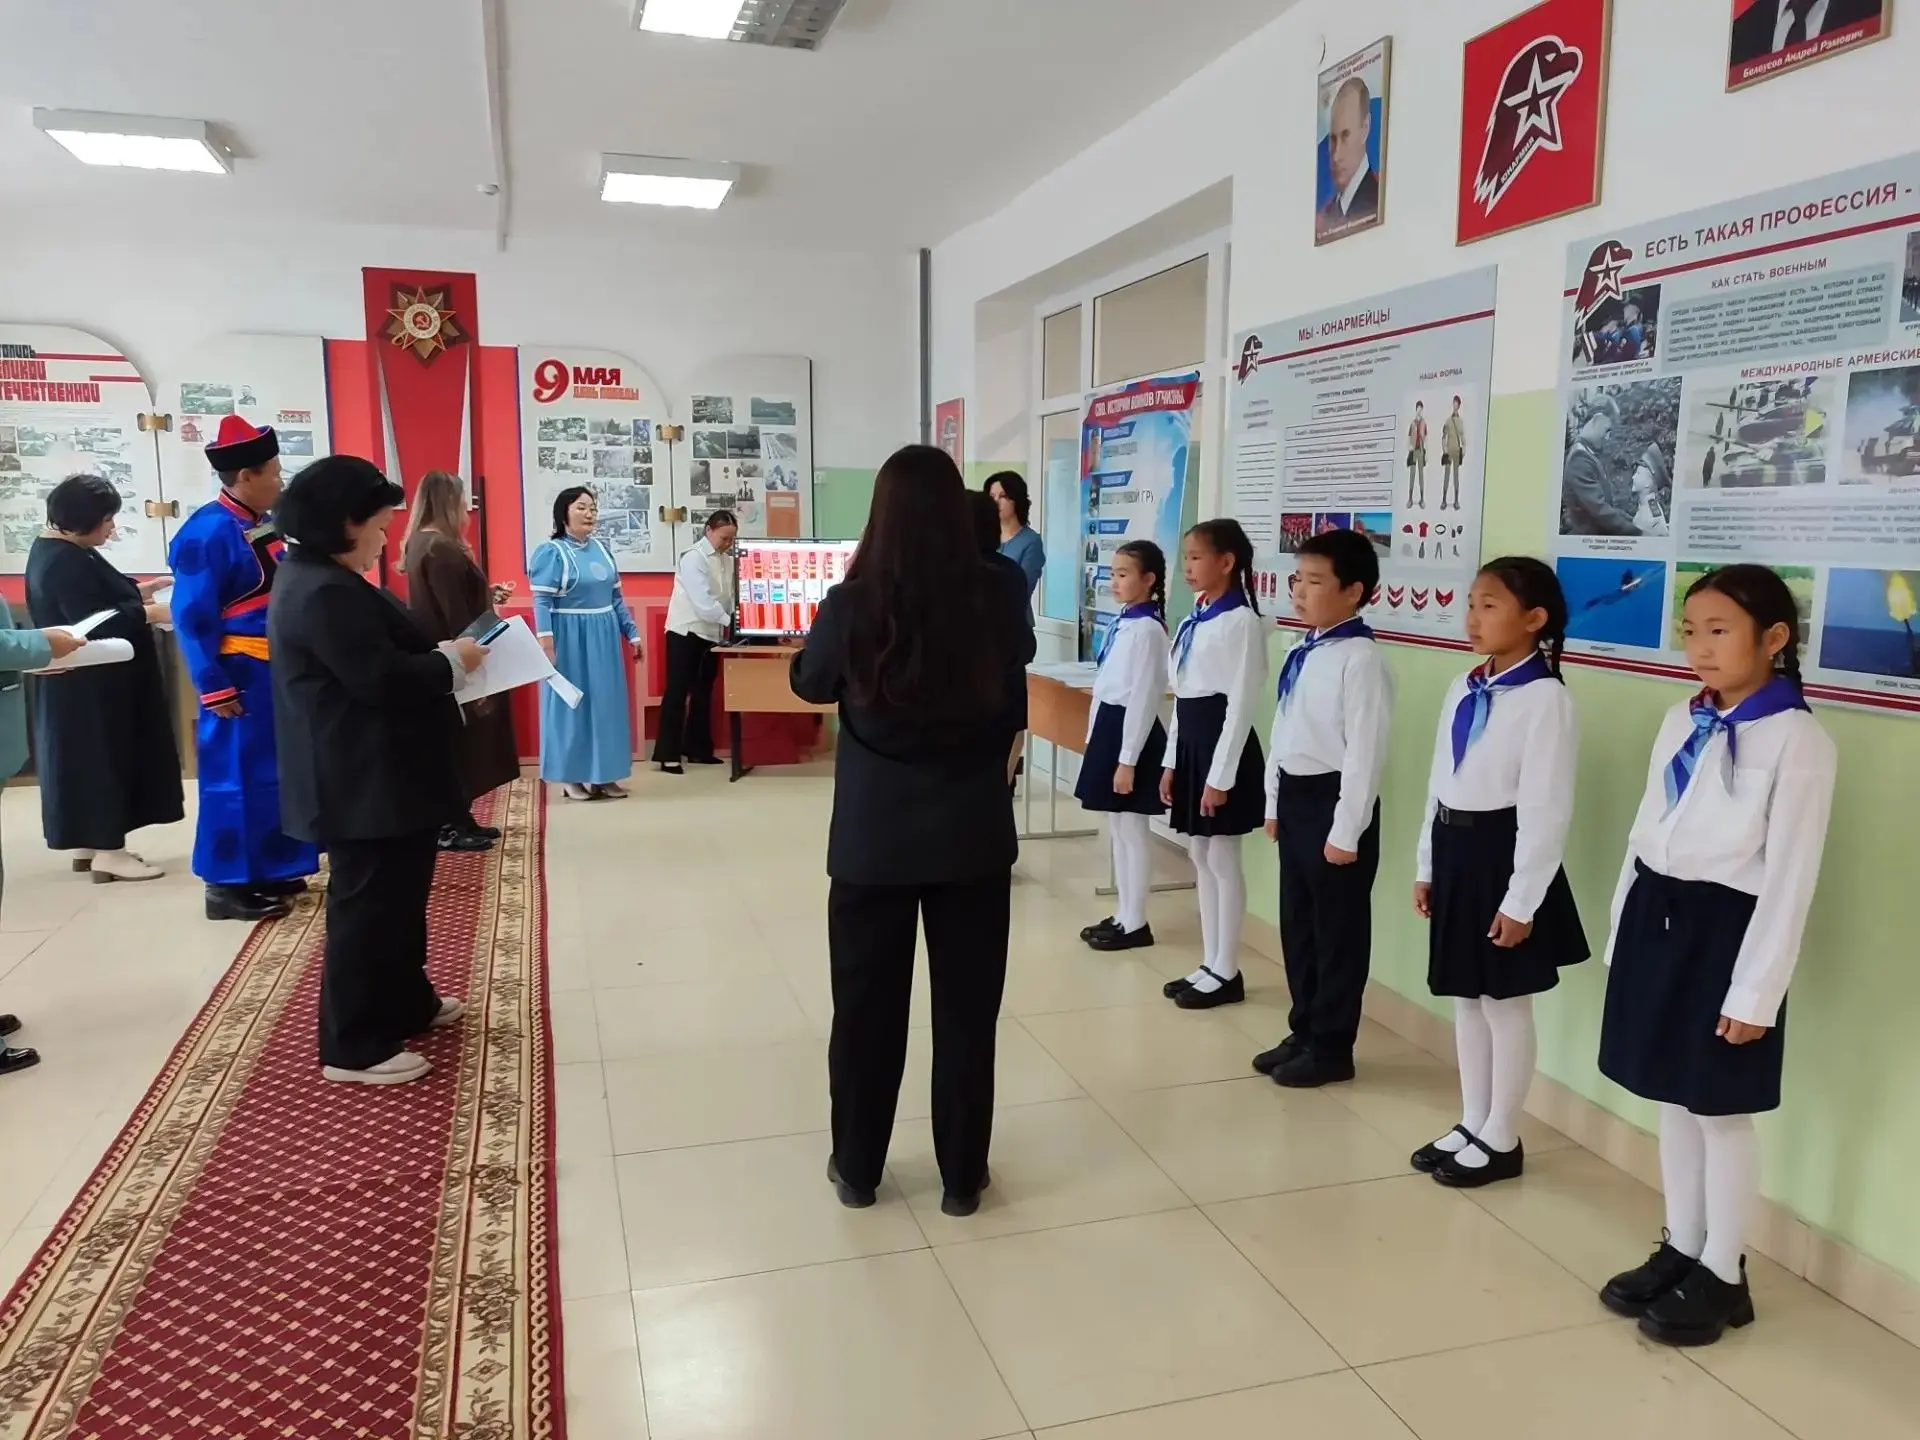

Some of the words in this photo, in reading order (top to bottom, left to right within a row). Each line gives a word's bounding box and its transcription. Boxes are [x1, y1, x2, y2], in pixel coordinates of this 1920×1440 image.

[1743, 58, 1783, 79] Белоусов
[1784, 45, 1818, 64] Андрей
[1820, 29, 1864, 53] Рэмович
[1500, 136, 1535, 184] ЮНАРМИЯ
[1645, 234, 1688, 258] ЕСТЬ
[1695, 217, 1754, 247] ТАКАЯ
[1760, 182, 1897, 232] ПРОФЕССИЯ
[1711, 277, 1731, 289] КАК
[1733, 271, 1765, 285] СТАТЬ
[1769, 258, 1827, 279] ВОЕННЫМ
[1298, 326, 1314, 342] МЫ
[1321, 308, 1391, 336] ЮНАРМЕЙЦЫ
[0, 344, 36, 359] ОПИСЬ
[0, 360, 47, 380] ЛИКОЙ
[533, 359, 570, 404] 9
[573, 367, 621, 386] МАЯ
[1419, 371, 1438, 380] НАША
[1439, 367, 1463, 377] ФОРМА
[1740, 357, 1844, 379] МЕЖДУНАРОДНЫЕ
